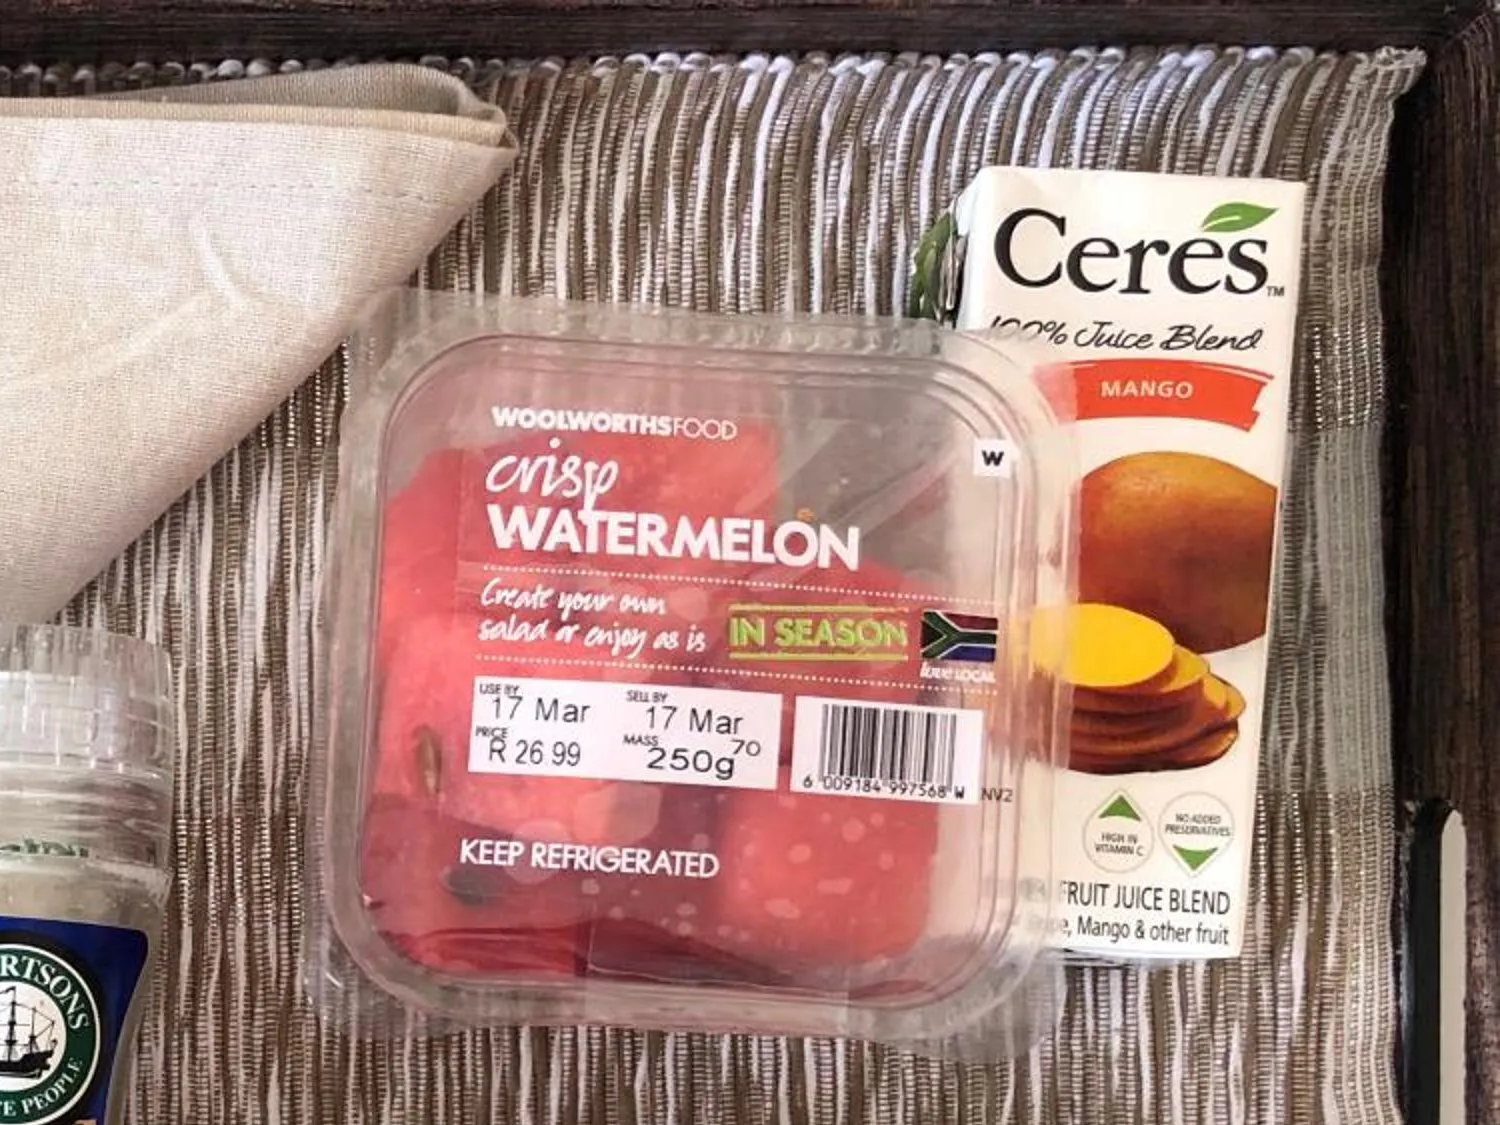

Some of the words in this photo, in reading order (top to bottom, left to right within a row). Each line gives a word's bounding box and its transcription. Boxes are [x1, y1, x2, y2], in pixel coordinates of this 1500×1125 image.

[1074, 321, 1154, 349] Juice
[1160, 324, 1264, 350] Blend
[1100, 381, 1195, 399] MANGO
[491, 407, 738, 440] WOOLWORTHSFOOD
[981, 449, 1005, 467] W
[486, 438, 618, 510] crisp
[486, 504, 860, 570] WATERMELON
[480, 577, 554, 607] Create
[558, 590, 615, 620] your
[619, 594, 666, 614] own
[478, 614, 550, 641] salad
[555, 623, 580, 643] or
[584, 621, 647, 659] enjoy
[653, 630, 679, 650] as
[686, 624, 707, 652] is
[729, 617, 765, 646] IN
[774, 619, 909, 649] SEASON
[479, 683, 501, 695] USE
[492, 696, 523, 720] 17
[535, 697, 591, 723] Mar
[646, 705, 677, 729] 17
[689, 707, 743, 735] Mar
[475, 726, 509, 738] PRICE
[623, 734, 659, 746] MASS
[489, 738, 506, 763] R
[647, 748, 735, 780] 250g
[803, 775, 813, 789] 6
[1094, 843, 1134, 856] VITAMIN
[1136, 846, 1145, 857] C
[1100, 832, 1125, 844] HIGH
[1128, 834, 1138, 845] IN
[460, 839, 525, 866] KEEP
[532, 843, 720, 878] REFRIGERATED
[1114, 885, 1163, 911] JUICE
[1169, 888, 1231, 915] BLEND
[1077, 916, 1130, 943] Mango
[1134, 920, 1146, 939] &
[1150, 922, 1191, 943] other
[1196, 922, 1229, 945] fruit
[21, 1055, 84, 1116] PEOPLE
